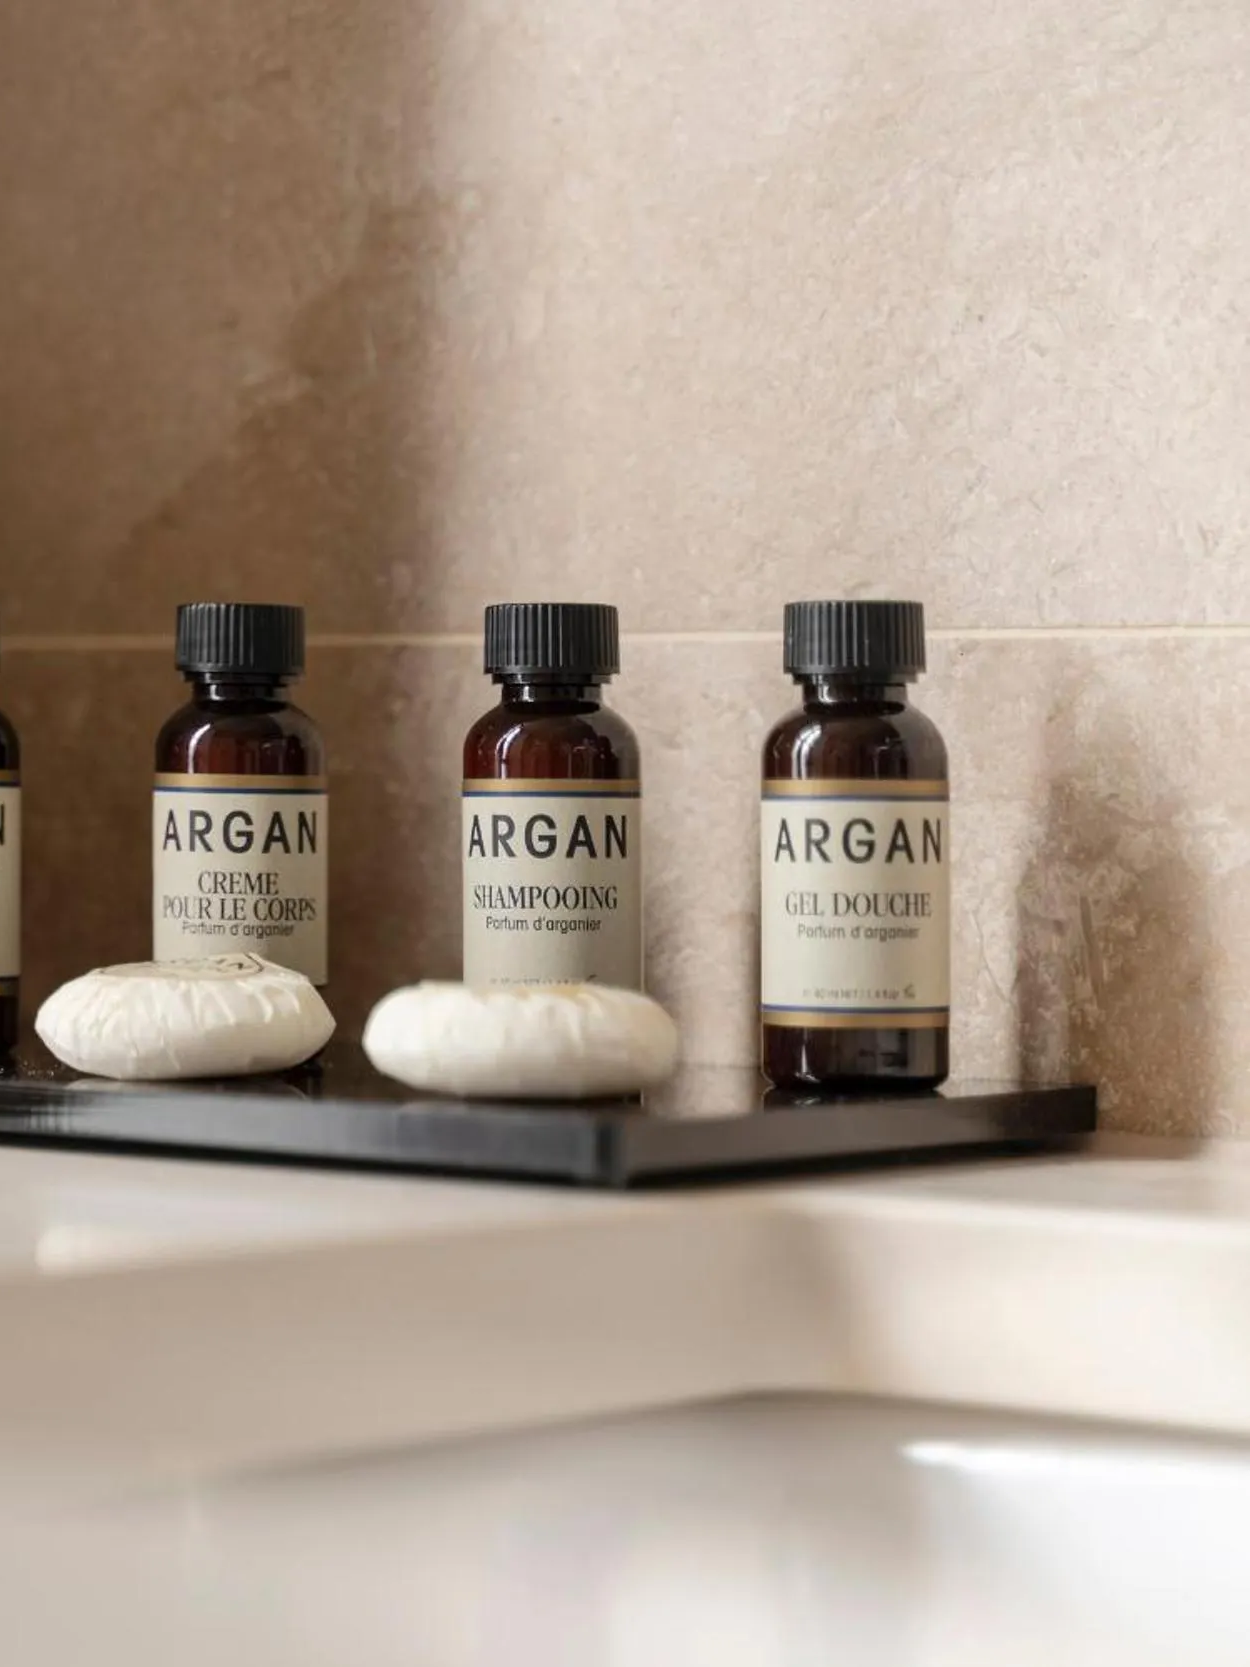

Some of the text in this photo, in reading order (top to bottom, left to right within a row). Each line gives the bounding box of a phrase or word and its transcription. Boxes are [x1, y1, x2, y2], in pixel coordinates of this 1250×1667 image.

[162, 808, 318, 854] ARGAN
[468, 813, 628, 859] ARGAN
[774, 817, 942, 864] ARGAN
[198, 871, 280, 895] CREME
[162, 895, 318, 922] POUR LE CORPS
[473, 884, 619, 911] SHAMPOOING
[785, 890, 932, 918] GEL DOUCHE
[485, 915, 603, 935] Parfum d'arganier
[797, 922, 920, 943] Parfum d'arganier
